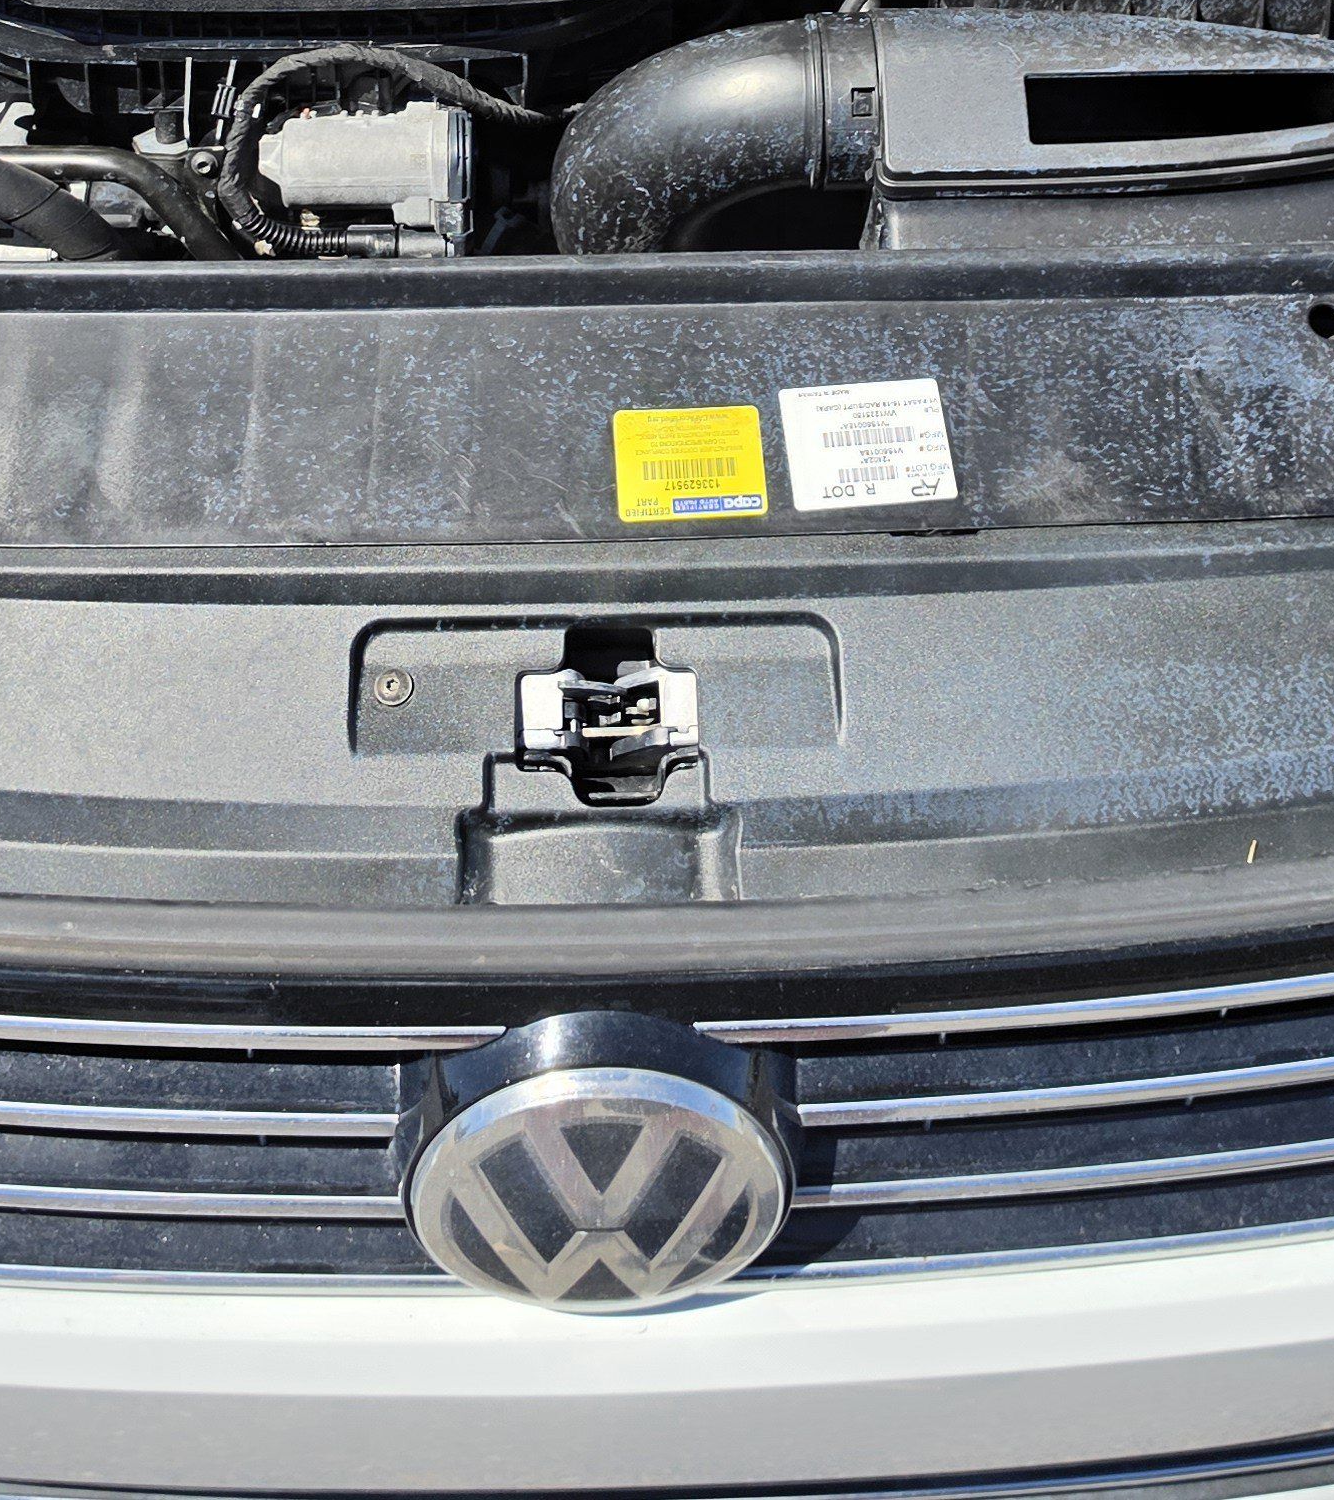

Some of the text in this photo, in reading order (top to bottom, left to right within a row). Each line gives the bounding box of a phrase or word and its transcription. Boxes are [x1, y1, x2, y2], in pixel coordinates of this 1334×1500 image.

[664, 479, 720, 491] 133629517
[823, 483, 876, 498] R DOT
[636, 497, 658, 506] PART
[674, 503, 720, 511] CERTIFIED
[723, 496, 761, 508] capa
[626, 507, 670, 517] CERTIFIED
